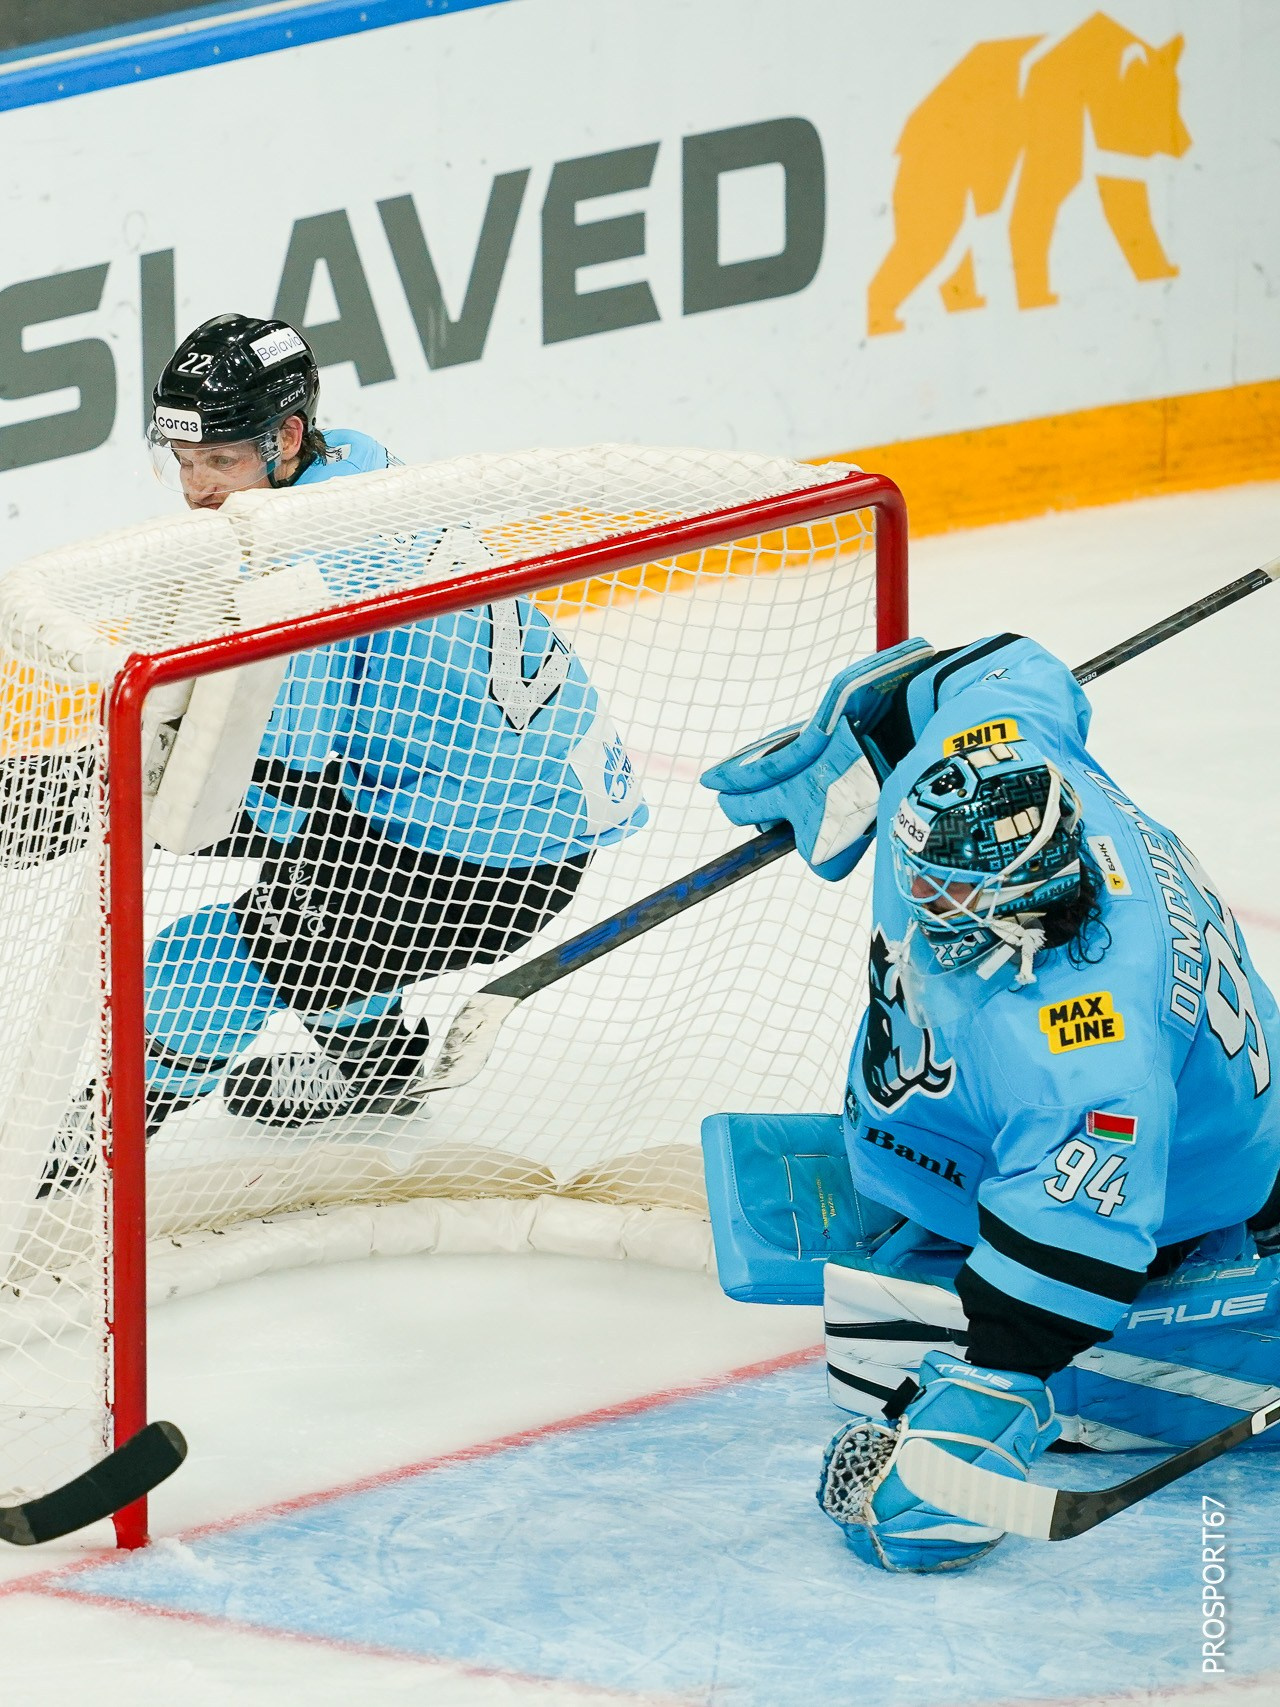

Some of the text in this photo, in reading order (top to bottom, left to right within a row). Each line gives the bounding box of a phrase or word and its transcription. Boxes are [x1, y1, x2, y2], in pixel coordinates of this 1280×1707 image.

[257, 333, 303, 361] Belavia
[177, 352, 214, 375] 22
[280, 387, 307, 409] CCM
[157, 416, 199, 433] согаз
[953, 723, 1008, 751] LINE
[1050, 996, 1104, 1027] MAX
[1059, 1018, 1116, 1048] LINE
[861, 1123, 967, 1191] Bank
[1043, 1140, 1126, 1217] 94
[1122, 1293, 1268, 1330] RUE
[935, 1363, 1014, 1390] TRUE
